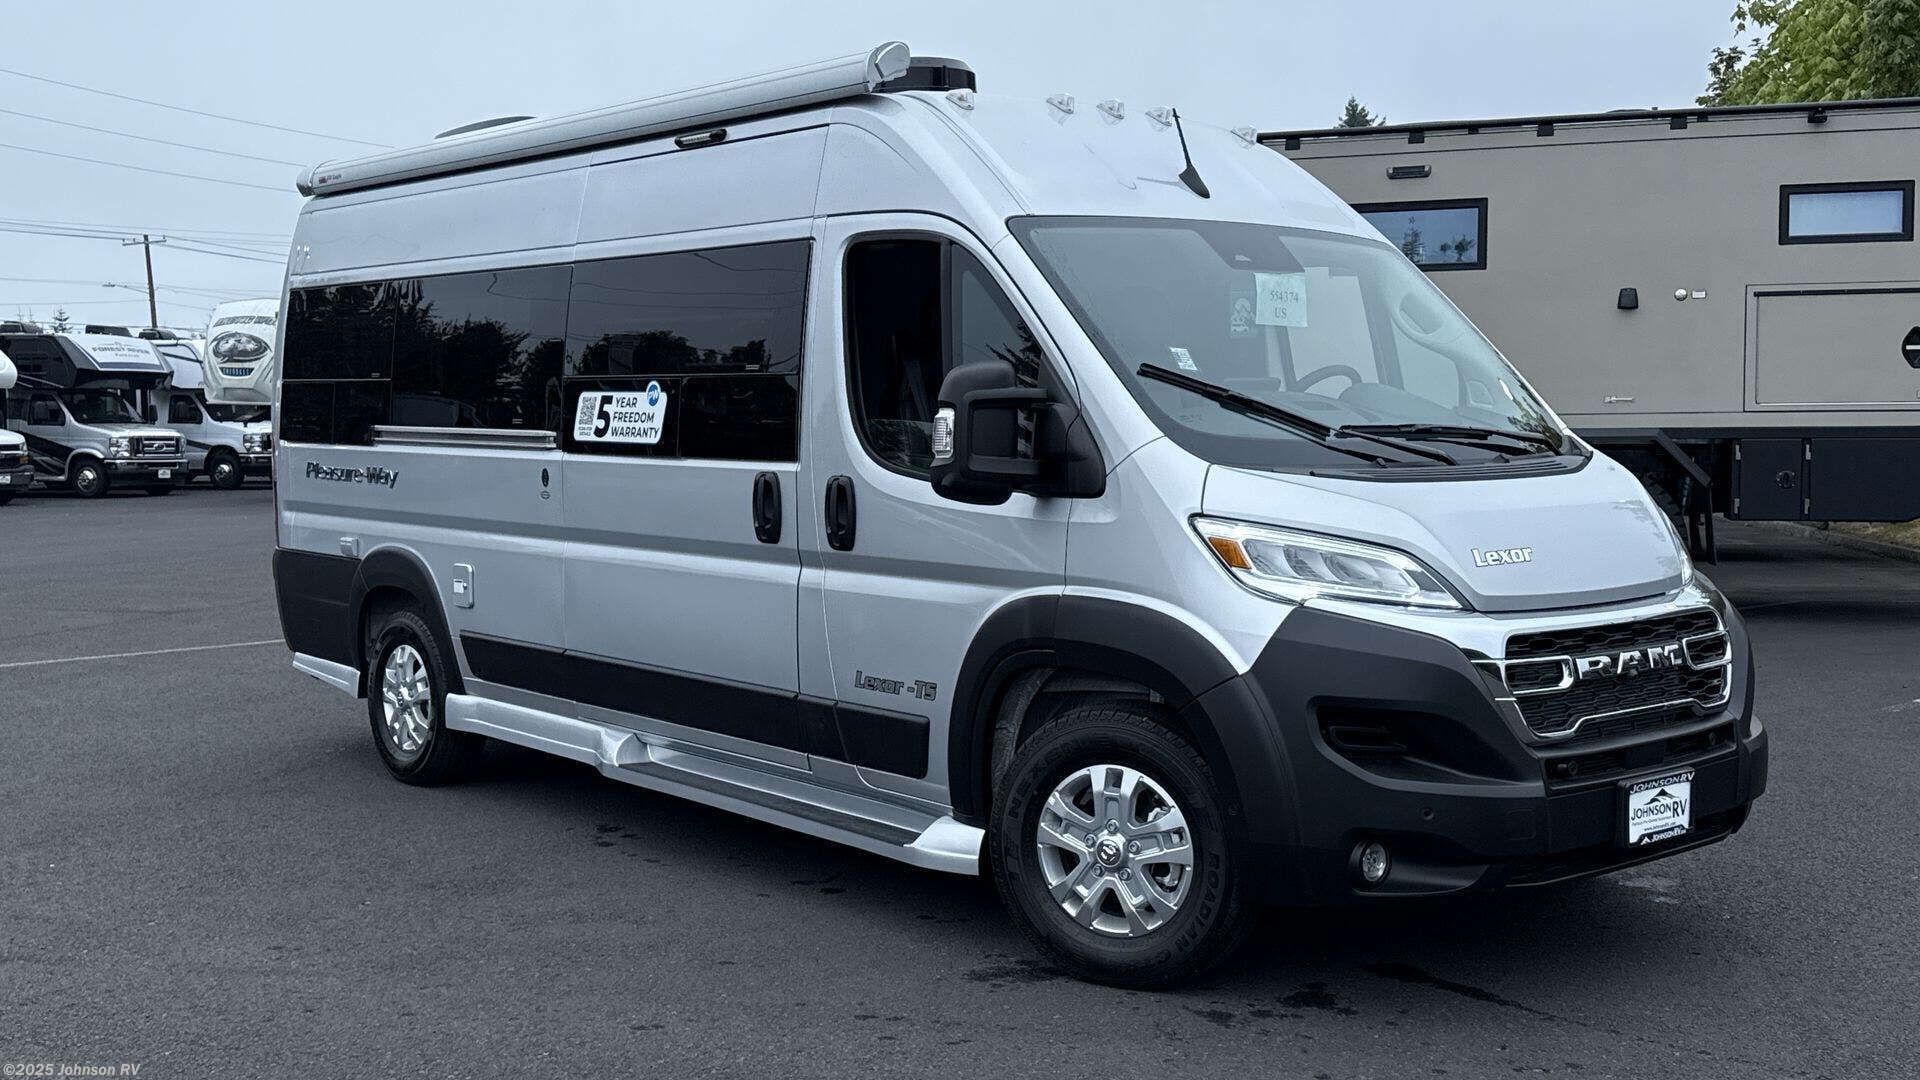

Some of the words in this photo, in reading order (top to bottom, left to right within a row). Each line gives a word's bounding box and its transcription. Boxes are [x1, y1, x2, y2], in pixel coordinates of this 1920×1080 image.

[1274, 308, 1287, 319] US
[615, 397, 638, 408] YEAR
[593, 395, 613, 438] 5
[612, 411, 655, 423] FREEDOM
[611, 426, 660, 438] WARRANTY
[306, 461, 399, 488] Pleasure-Way
[1471, 547, 1532, 568] Lexor
[1575, 644, 1682, 680] RAM
[854, 670, 904, 695] Lexor
